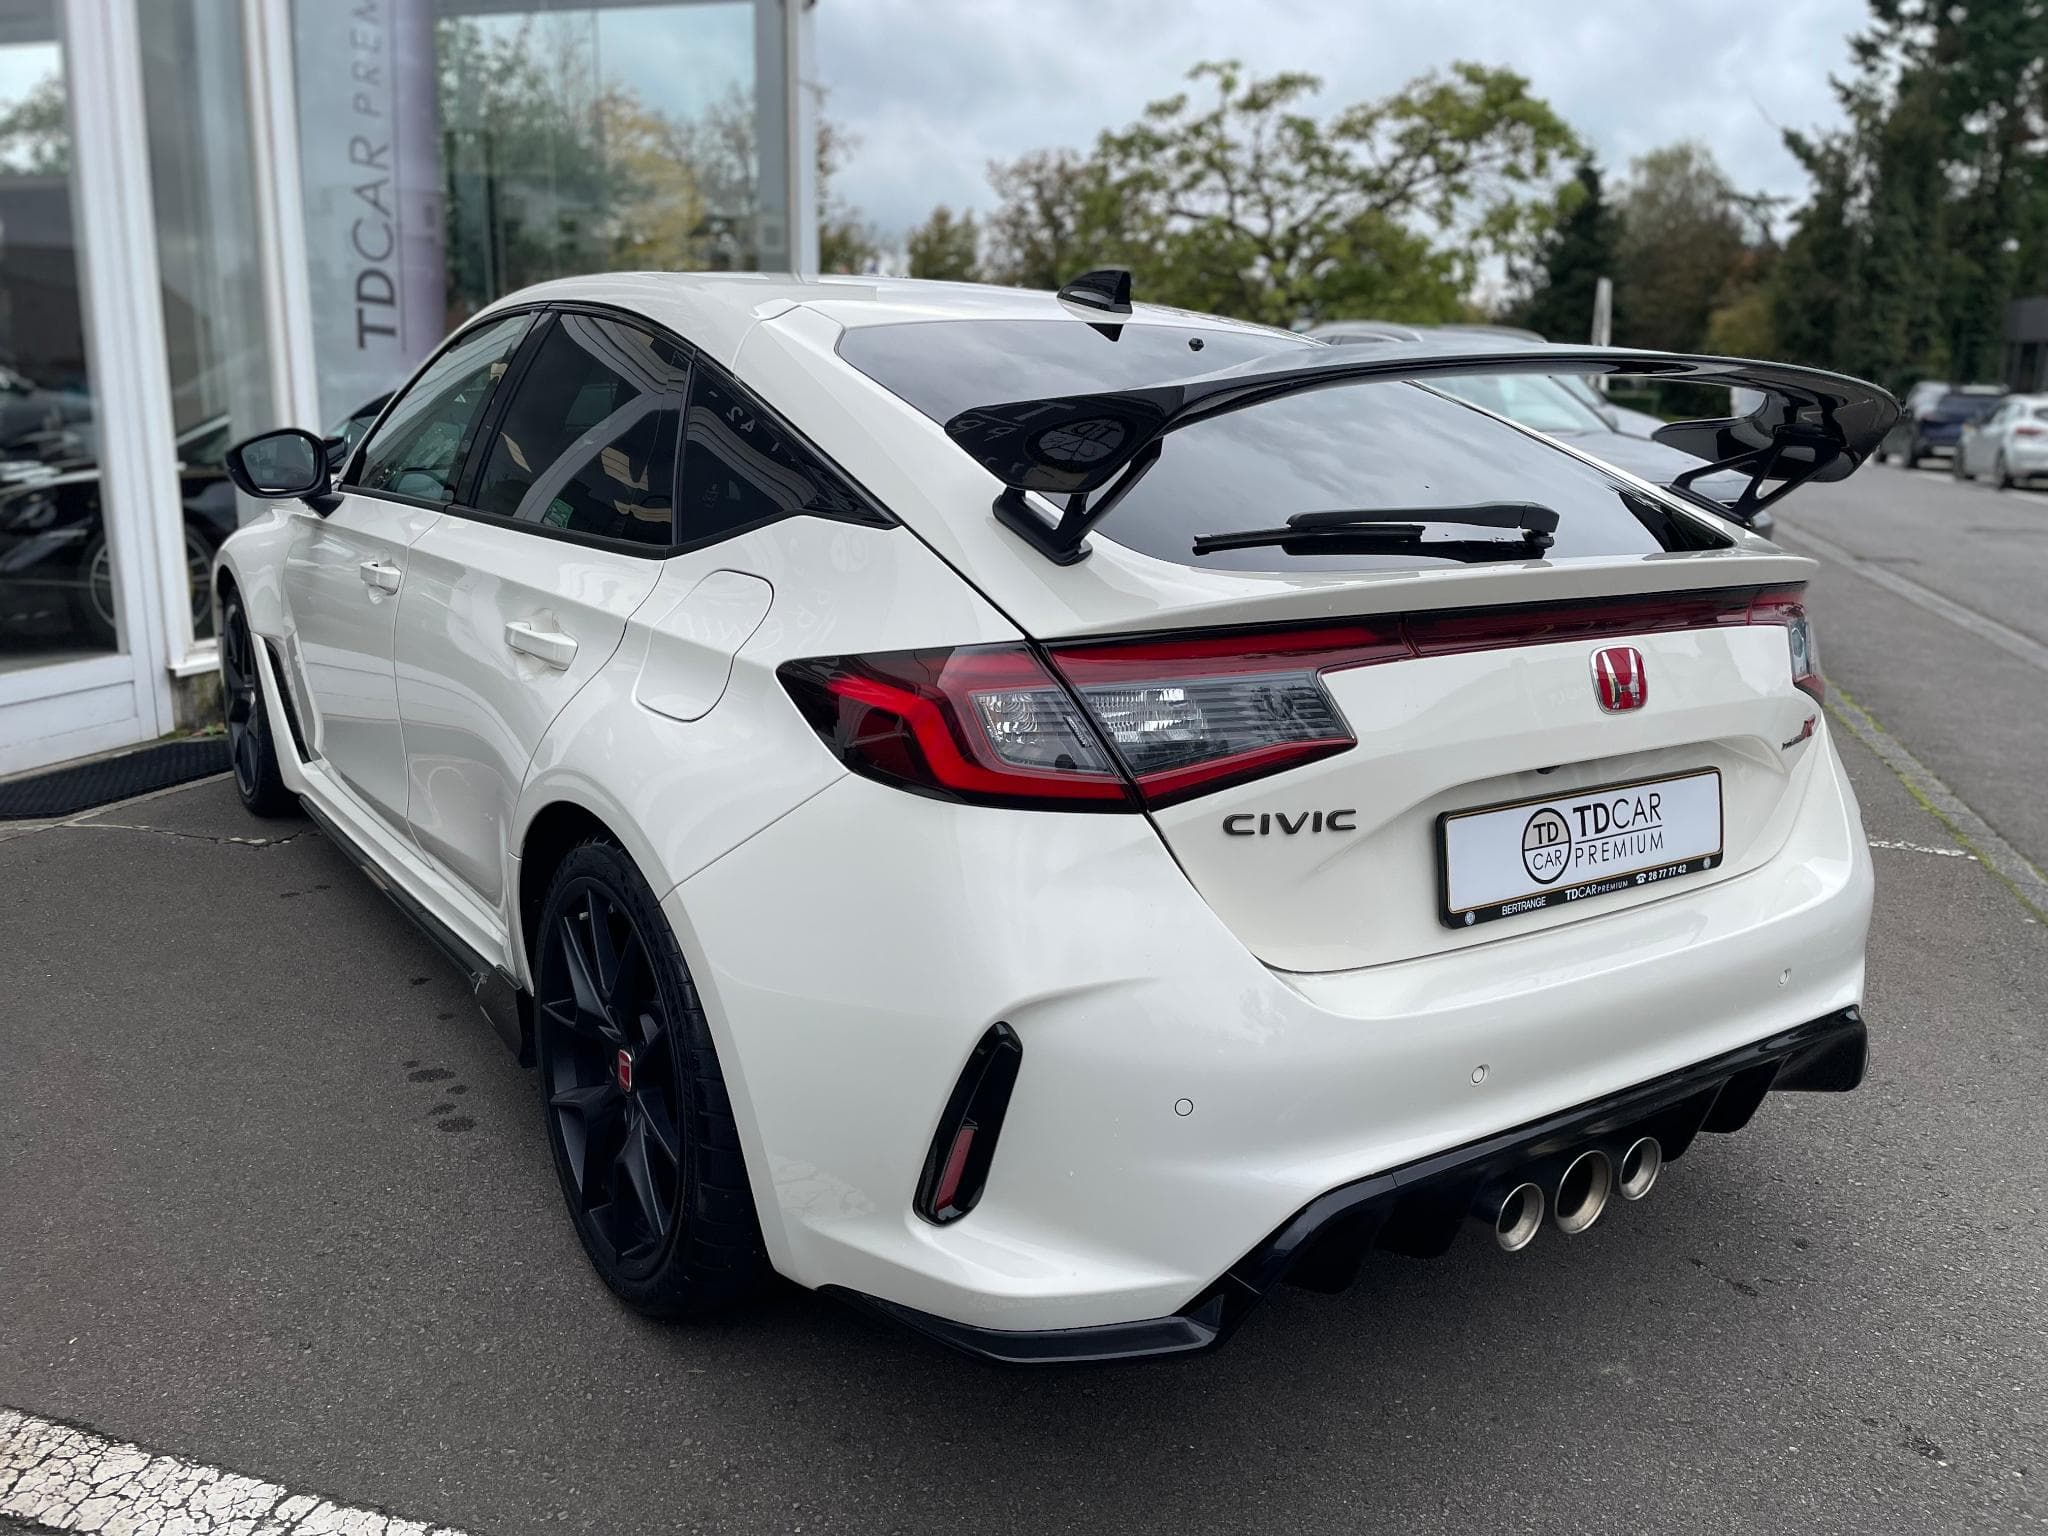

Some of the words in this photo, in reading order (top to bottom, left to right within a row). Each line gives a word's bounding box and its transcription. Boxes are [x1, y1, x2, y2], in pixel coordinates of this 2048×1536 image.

[350, 134, 398, 350] TDCAR
[1222, 808, 1357, 836] CIVIC
[1533, 821, 1560, 845] TD
[1573, 792, 1662, 838] TDCAR
[1533, 849, 1563, 871] CAR
[1575, 831, 1664, 868] PREMIUM
[1501, 896, 1547, 916] BERTRANGE
[1565, 884, 1597, 901] TDCAR
[1597, 880, 1629, 894] PREMIUM
[1659, 868, 1667, 879] 77
[1668, 866, 1677, 876] 77
[1678, 864, 1687, 874] 42
